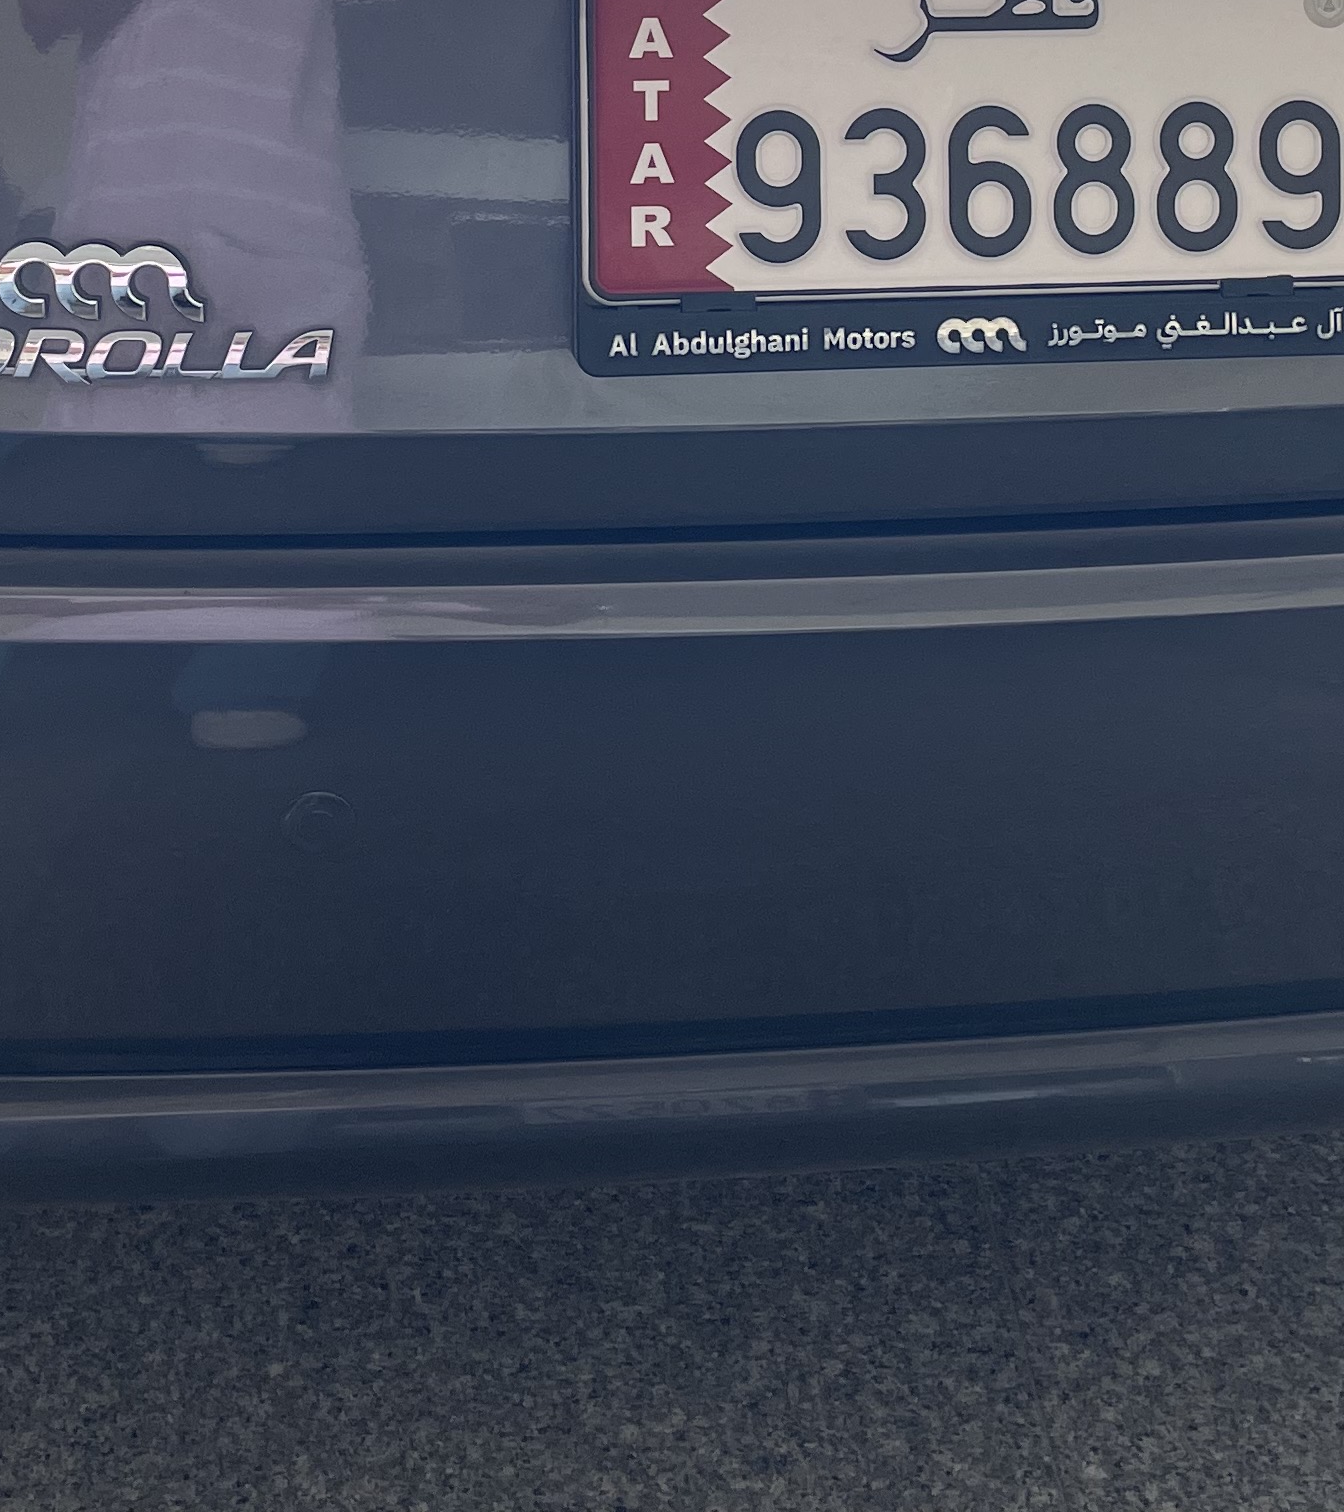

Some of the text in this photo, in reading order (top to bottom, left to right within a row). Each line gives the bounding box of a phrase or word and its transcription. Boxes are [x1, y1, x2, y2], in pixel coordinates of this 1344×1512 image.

[735, 99, 1342, 265] 936889
[1047, 318, 1148, 348] موتورز
[1156, 311, 1309, 351] عبدالغني
[1317, 306, 1344, 341] آل
[608, 333, 639, 358] Al
[651, 327, 810, 360] Abdulghani
[823, 326, 917, 352] Motors
